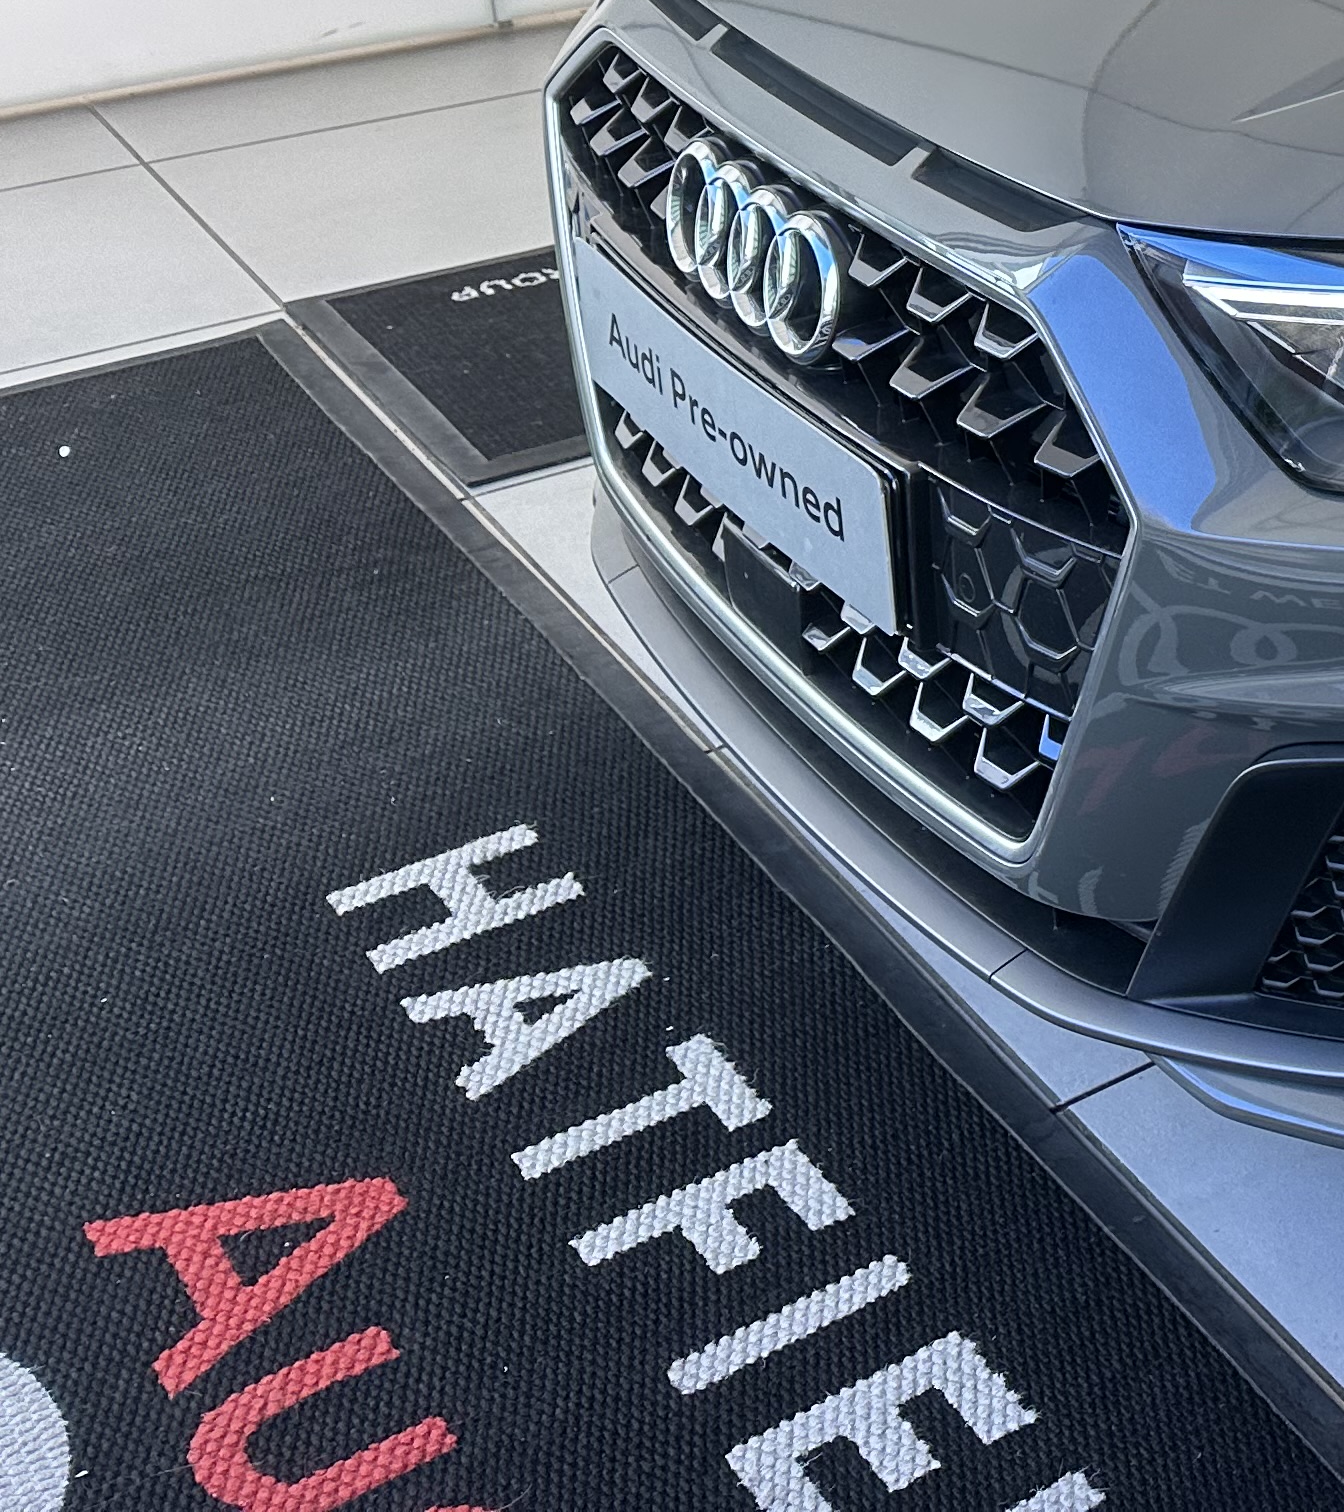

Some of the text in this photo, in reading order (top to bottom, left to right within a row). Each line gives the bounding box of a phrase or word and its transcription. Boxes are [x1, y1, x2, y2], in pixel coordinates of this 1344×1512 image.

[608, 313, 845, 542] Audi Pre-owned
[326, 821, 1106, 1511] HATFIE
[83, 1176, 500, 1511] AU
